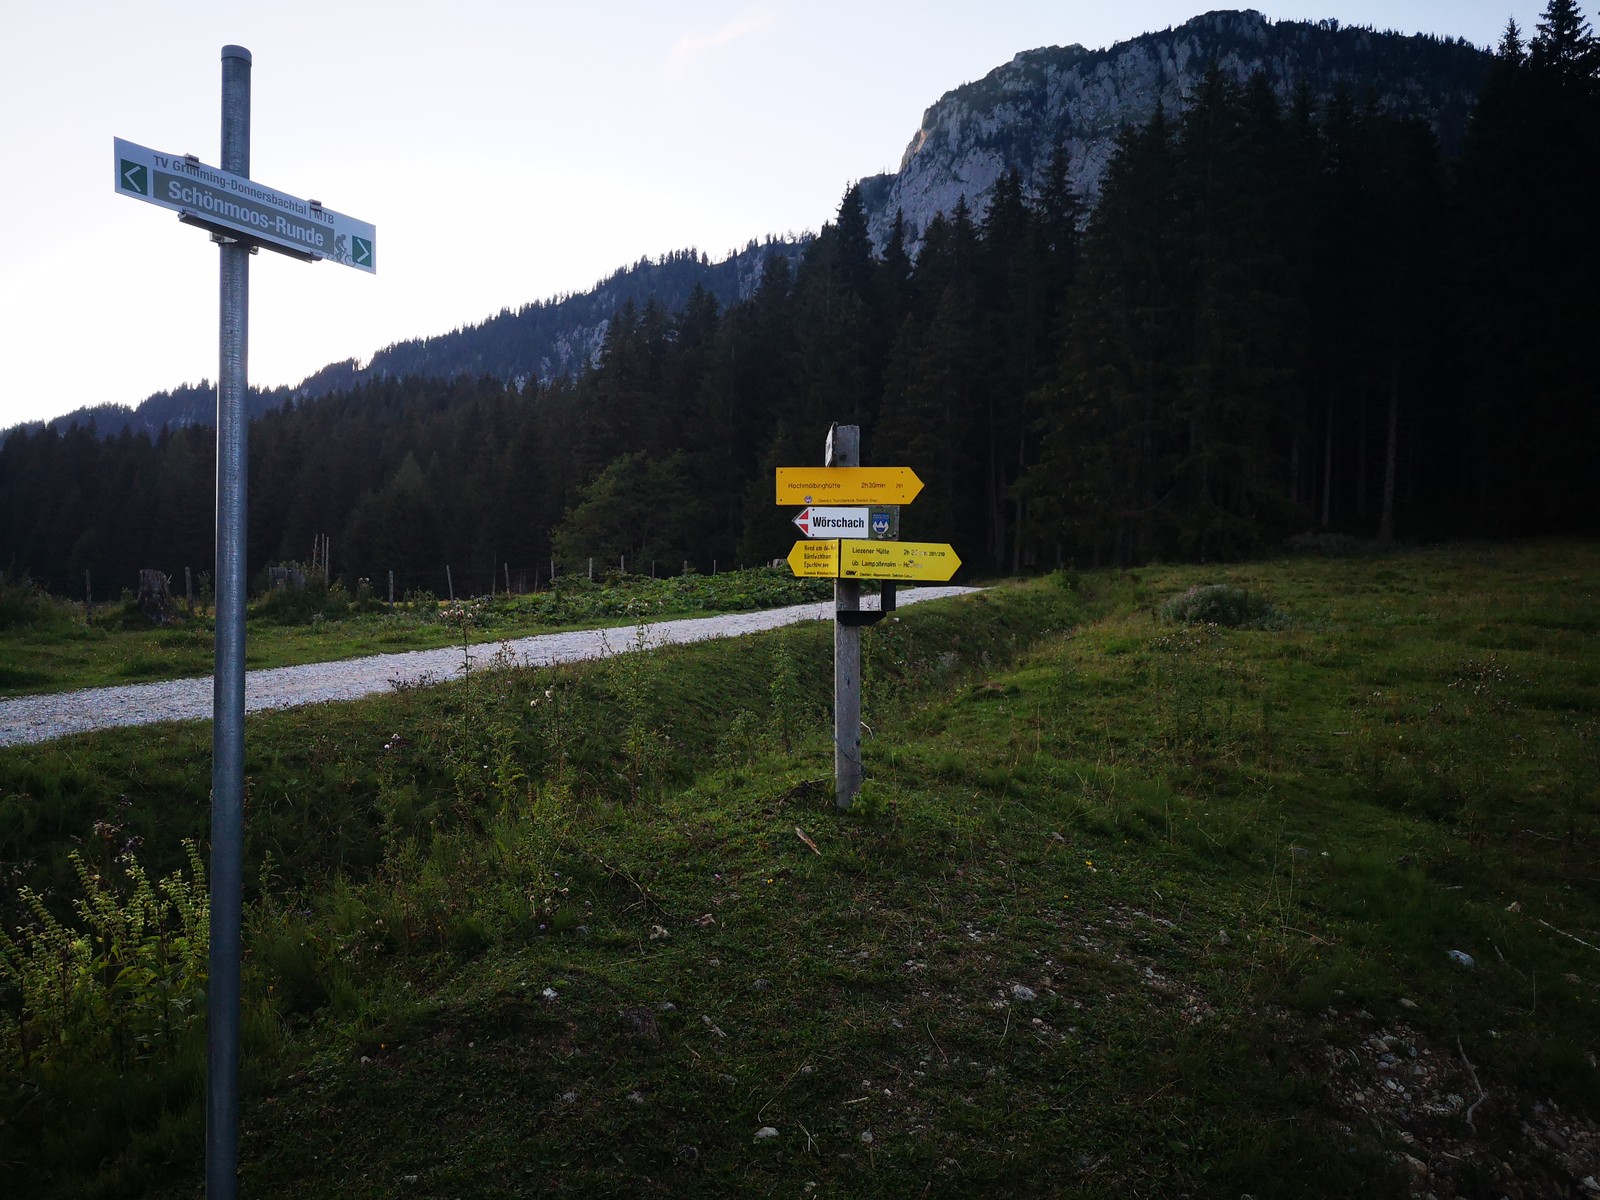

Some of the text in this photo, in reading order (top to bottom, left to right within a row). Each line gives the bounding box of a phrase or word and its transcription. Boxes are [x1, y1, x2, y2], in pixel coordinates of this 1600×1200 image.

[153, 155, 334, 224] TV Grimming-Donnersbachtal MTB
[168, 180, 324, 247] Schönmoos-Runde
[812, 516, 865, 528] Wörschach
[852, 546, 875, 554] Liezener
